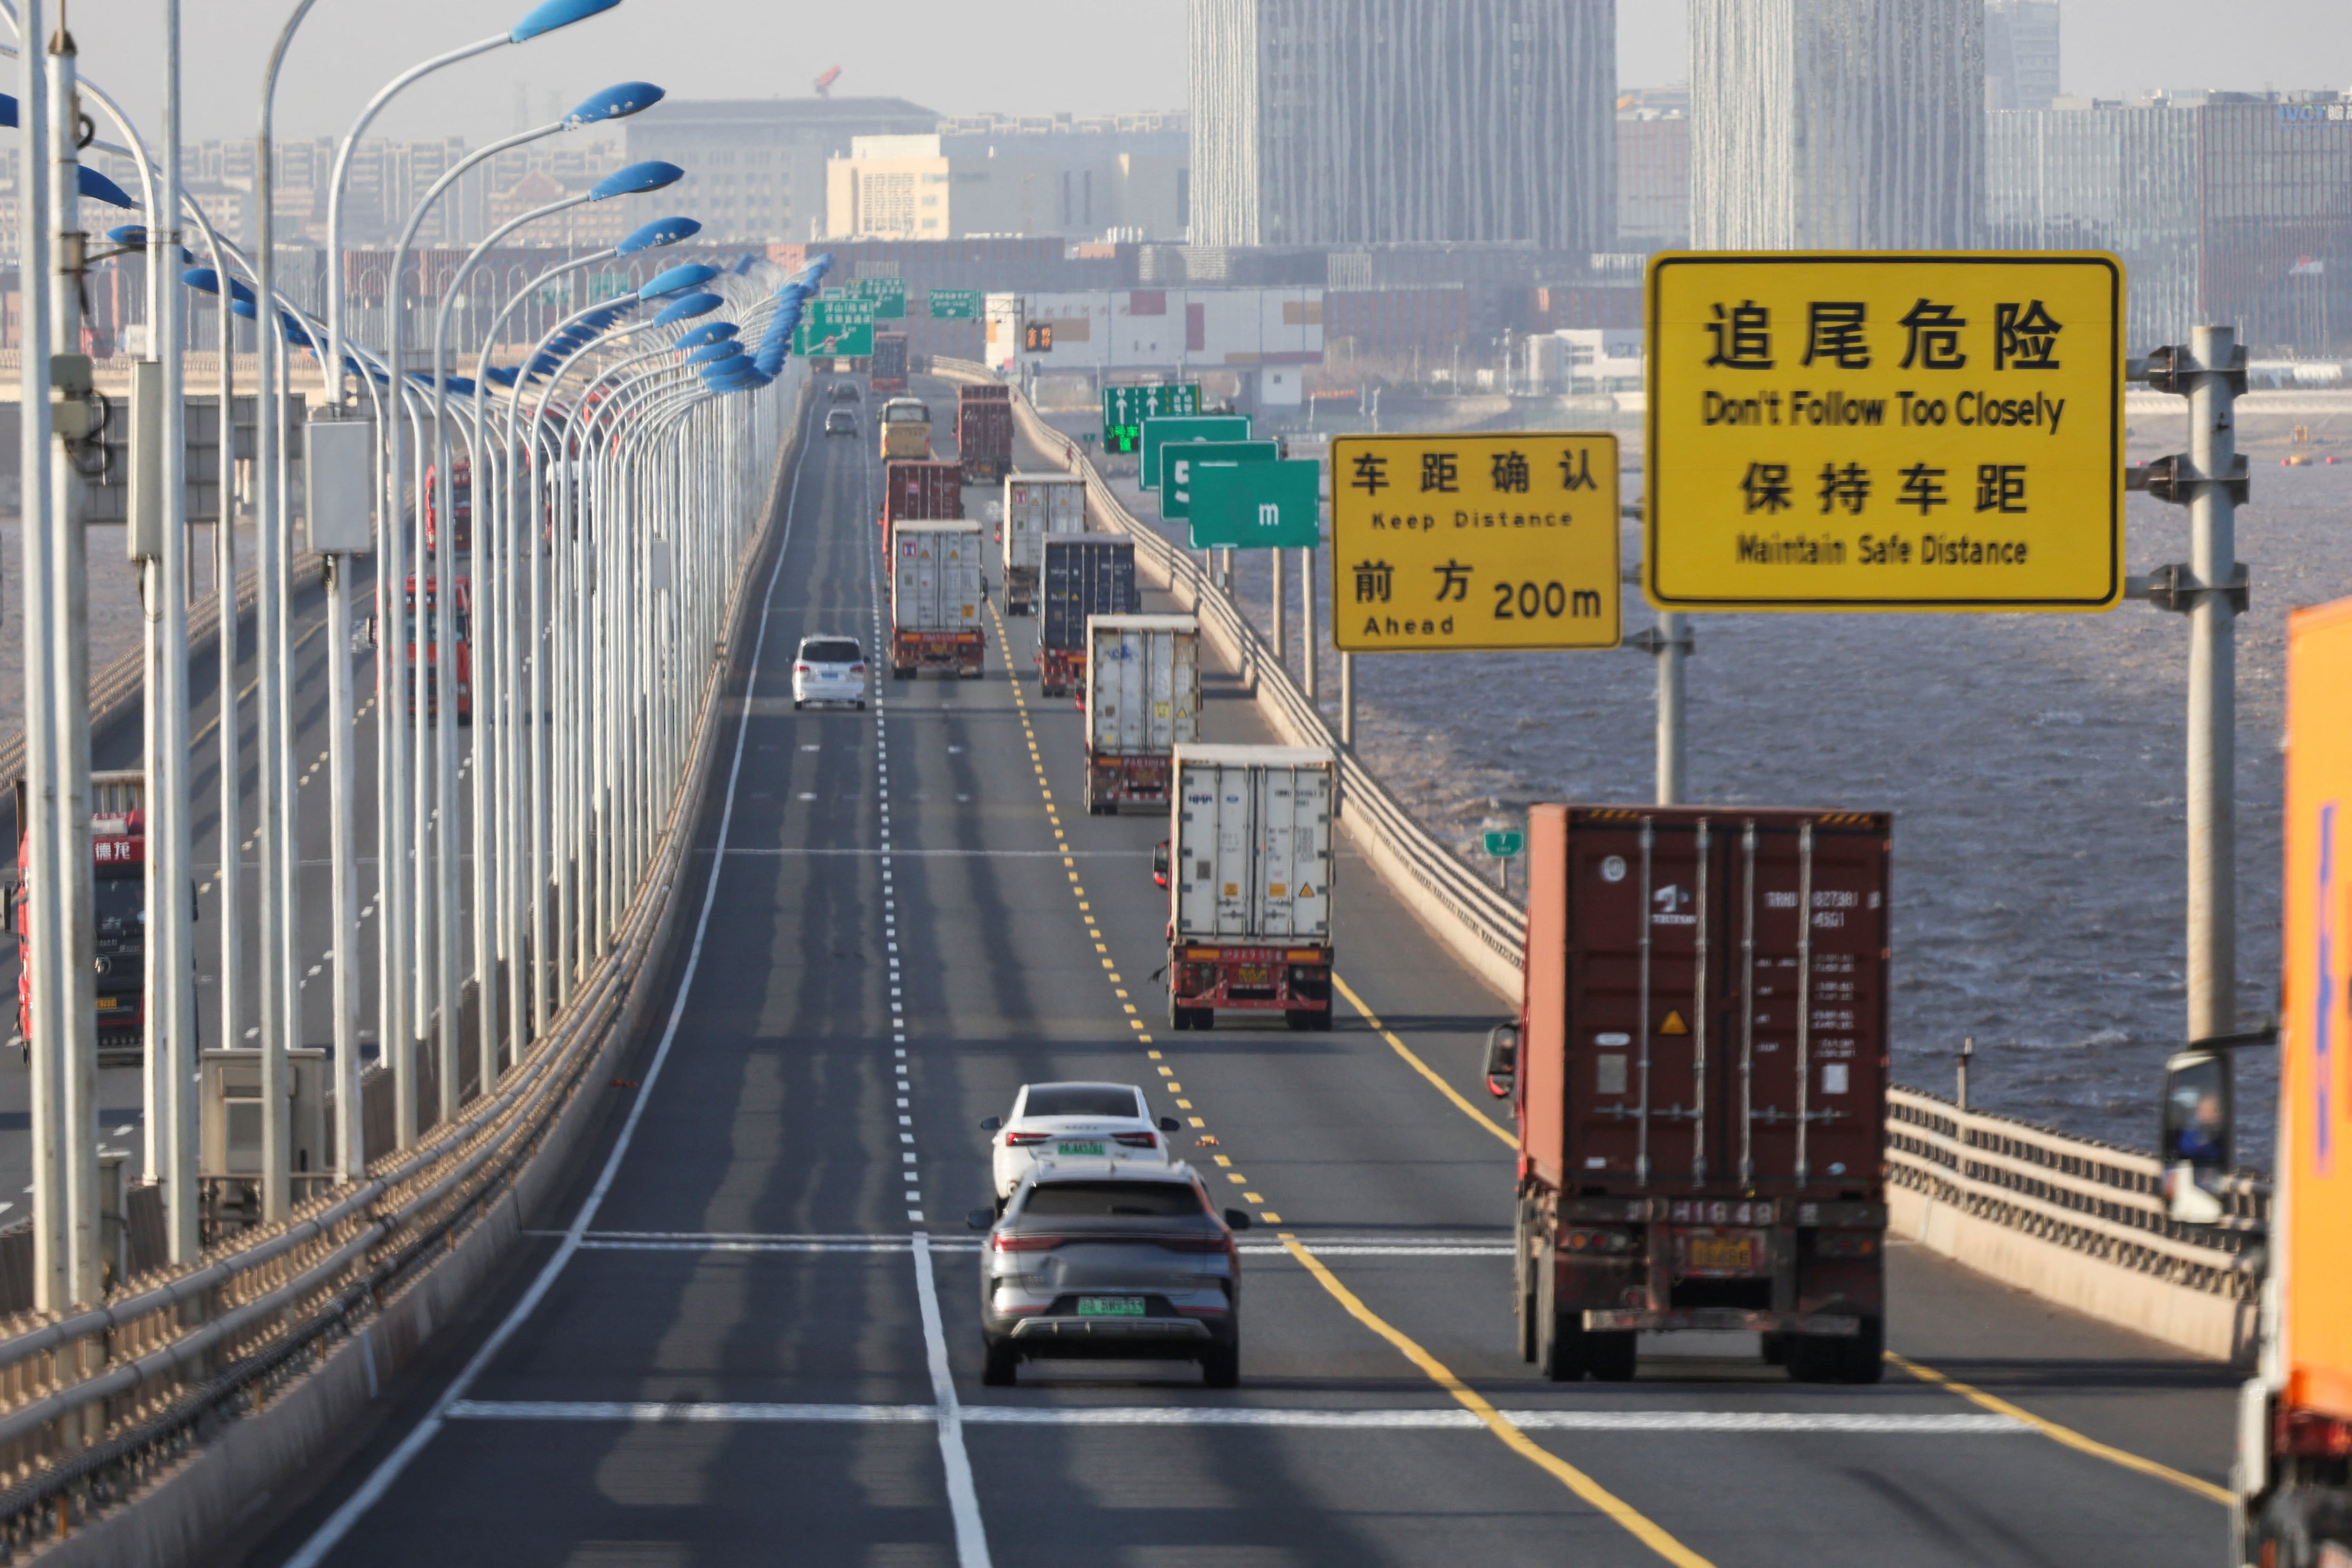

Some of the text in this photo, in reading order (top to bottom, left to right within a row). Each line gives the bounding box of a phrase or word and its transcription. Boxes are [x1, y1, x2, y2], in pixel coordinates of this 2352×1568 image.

[1704, 298, 2063, 371] 追尾危险
[1703, 390, 2065, 435] Don't Follow Too Closely
[1351, 449, 1597, 496] 车距确认
[1740, 462, 2027, 516] 保持车距
[1372, 511, 1572, 532] Keep Distance
[1737, 534, 2028, 565] Maintain Safe Distance
[1352, 559, 1601, 620] 前方 200m
[1363, 616, 1454, 636] Ahead
[95, 842, 130, 860] 德龙
